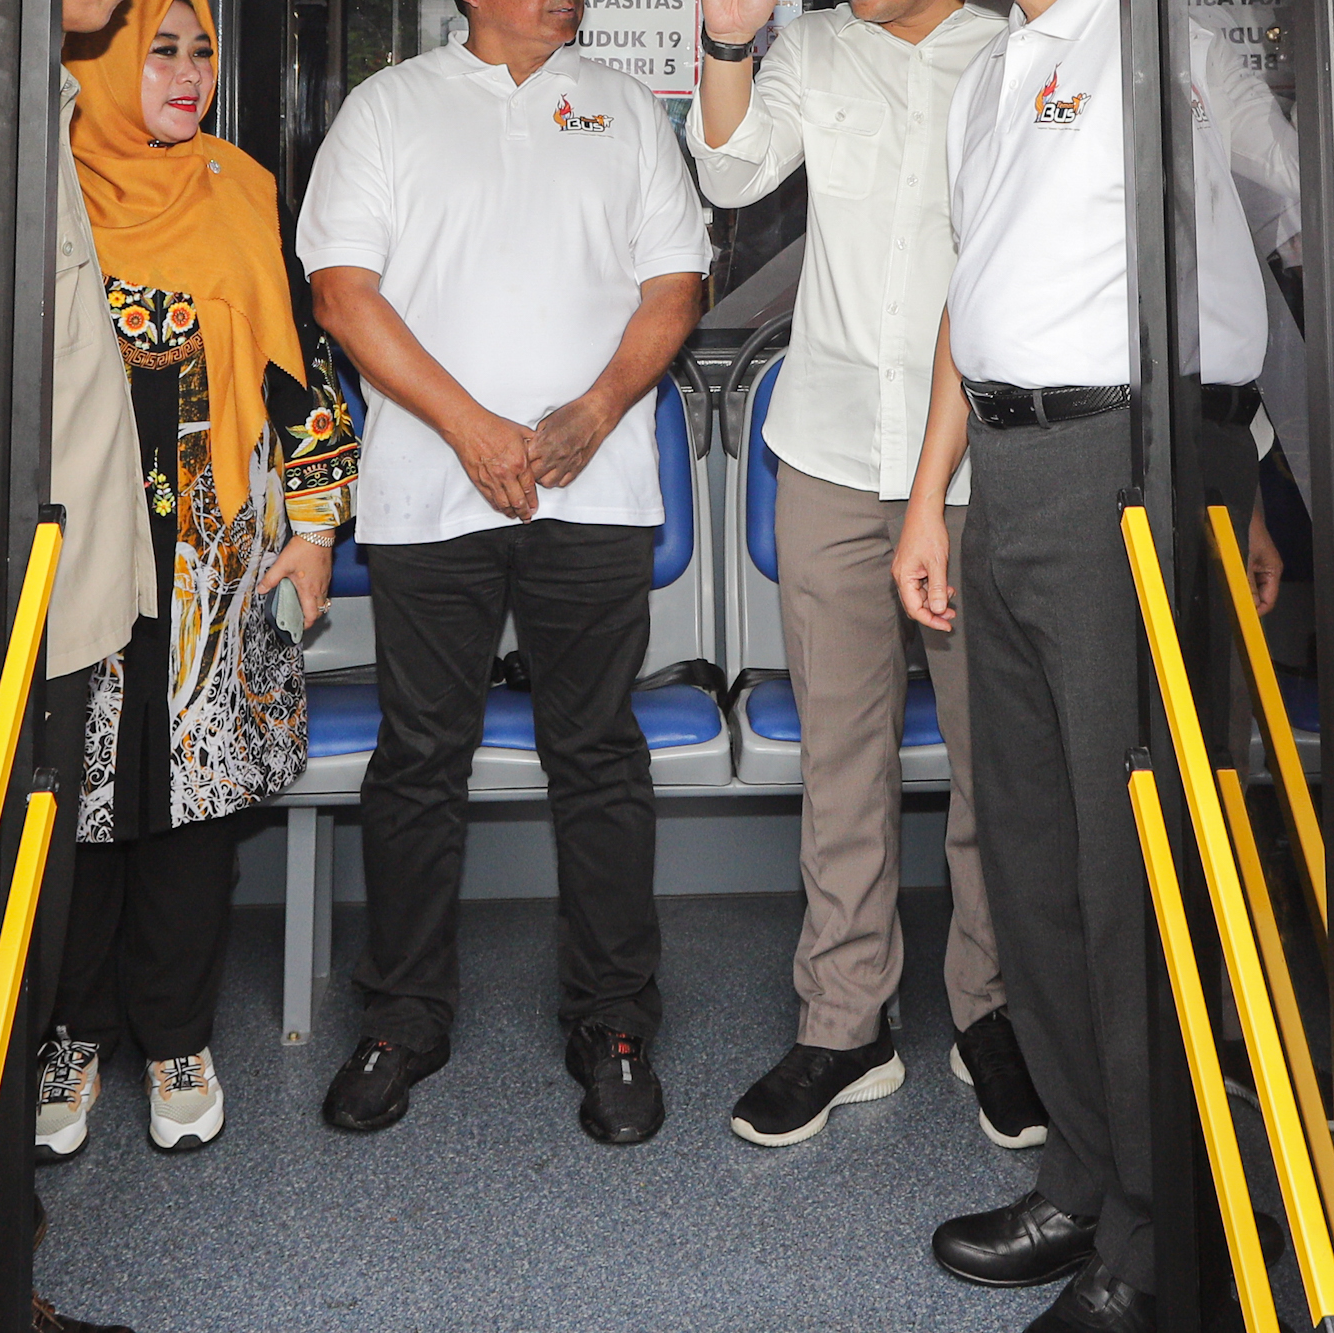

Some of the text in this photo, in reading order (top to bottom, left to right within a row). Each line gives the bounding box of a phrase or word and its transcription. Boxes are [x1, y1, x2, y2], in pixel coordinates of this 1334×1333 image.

[564, 30, 682, 48] UDUK 19
[663, 58, 676, 76] 5
